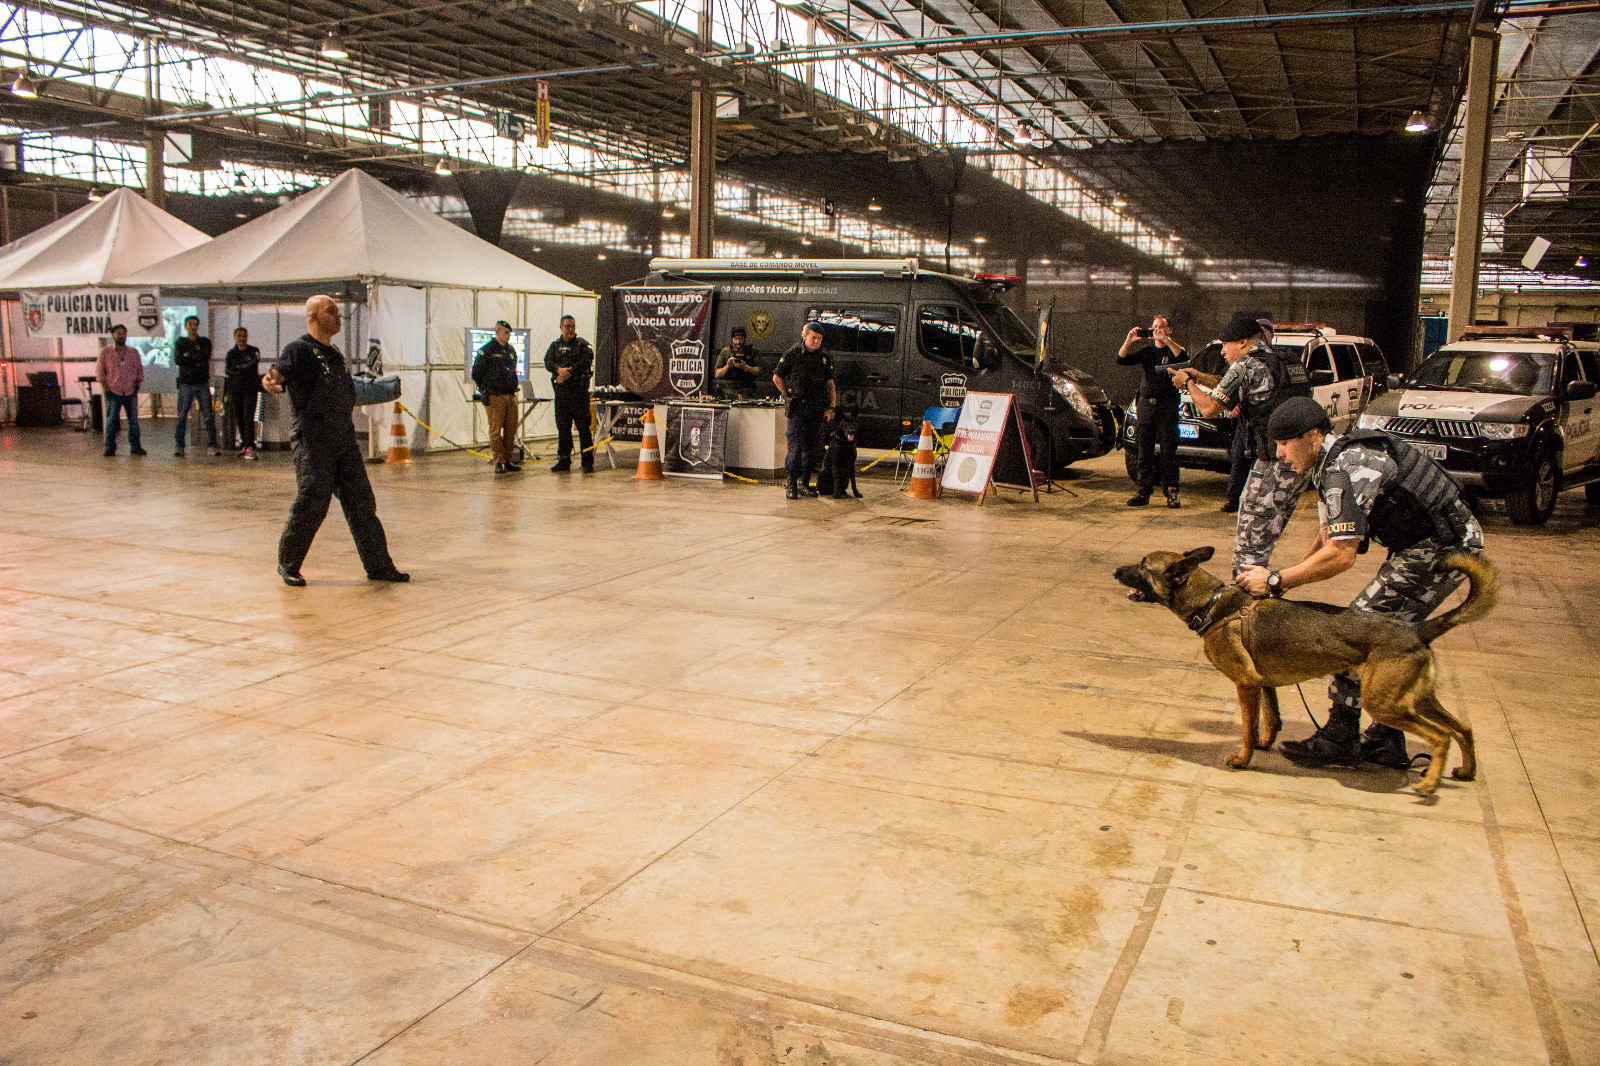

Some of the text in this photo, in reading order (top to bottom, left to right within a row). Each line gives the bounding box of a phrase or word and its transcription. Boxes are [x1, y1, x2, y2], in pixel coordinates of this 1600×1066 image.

[798, 286, 838, 295] ESPECIAIS
[47, 291, 129, 312] POLÍCIA CIVIL
[624, 294, 703, 304] DEPARTAMENTO
[657, 306, 671, 315] DA
[66, 313, 113, 334] PARANÁ
[669, 318, 696, 327] CIVIL
[957, 430, 997, 442] TREINAMENTO
[960, 443, 985, 454] POLICIAL
